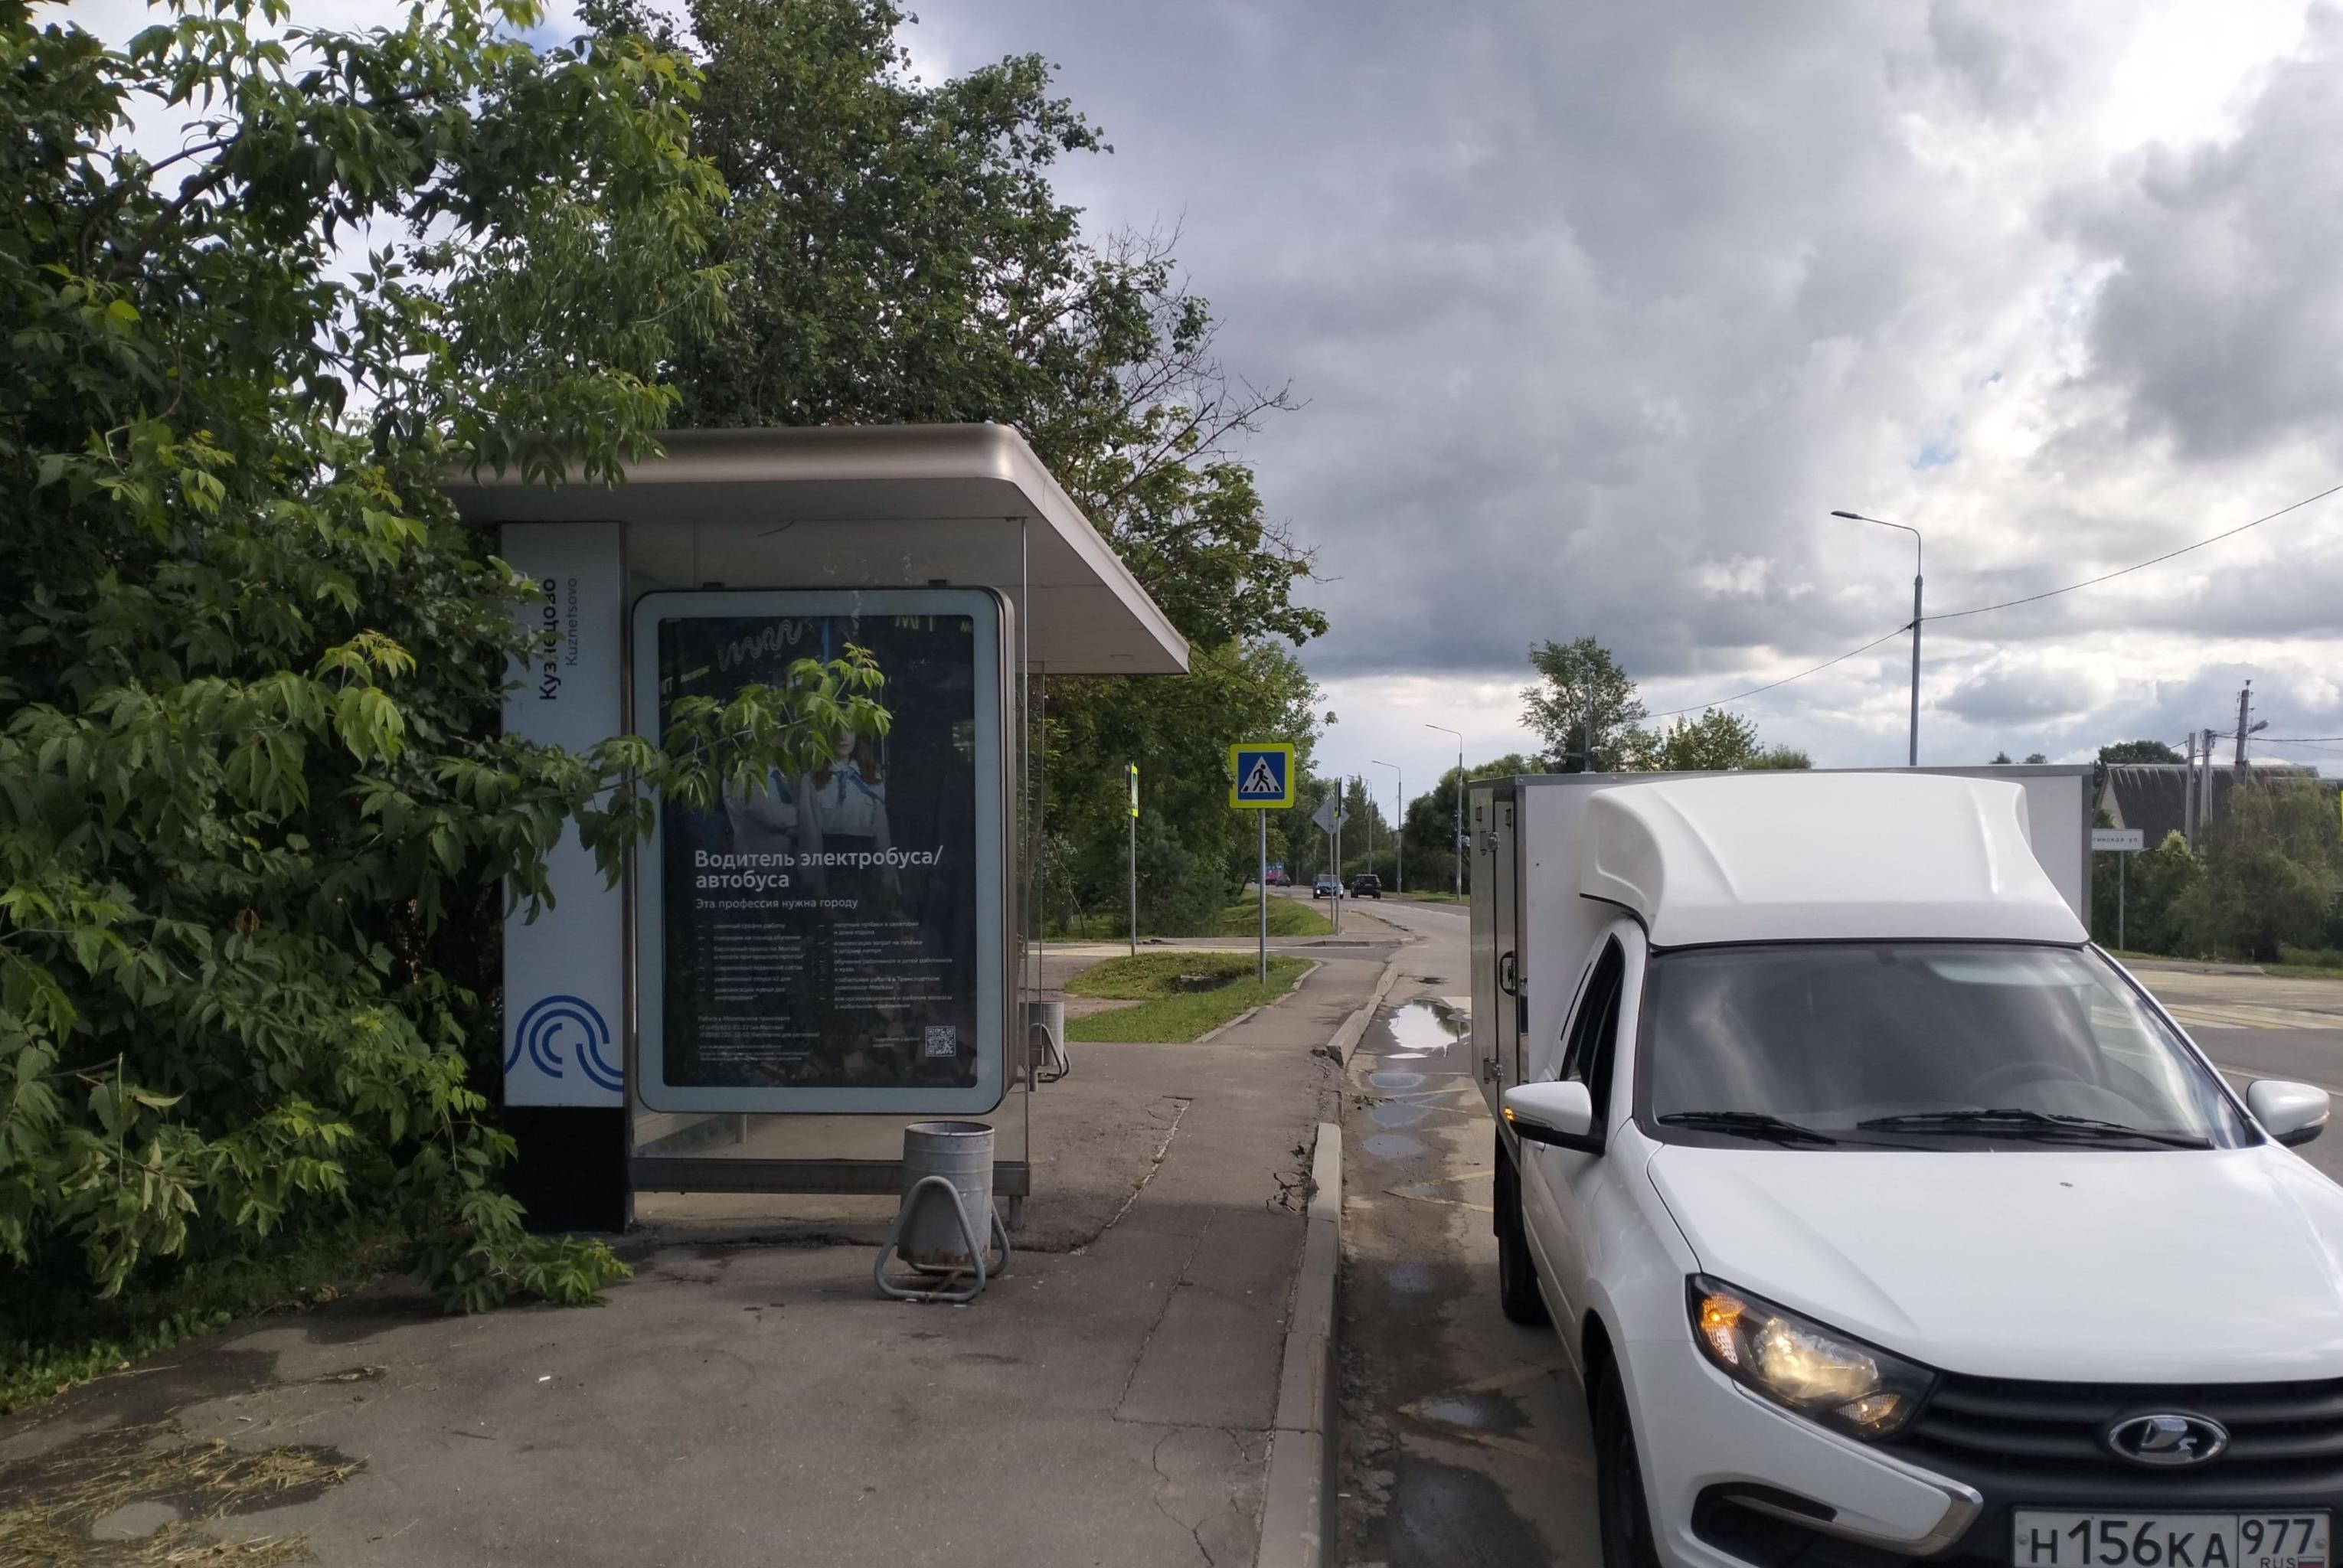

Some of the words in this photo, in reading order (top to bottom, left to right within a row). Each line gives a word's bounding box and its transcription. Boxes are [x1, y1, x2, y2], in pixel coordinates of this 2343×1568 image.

[565, 578, 577, 666] Kuznetsovo
[694, 850, 795, 870] Водитель
[800, 844, 943, 869] электробуса/
[695, 870, 789, 892] автобуса
[696, 899, 715, 909] Эта
[718, 898, 779, 910] профессия
[782, 899, 817, 910] нужна
[819, 898, 858, 910] городу
[2031, 1519, 2230, 1568] Н156КА
[2241, 1518, 2315, 1555] 977
[2260, 1557, 2296, 1568] RUS
